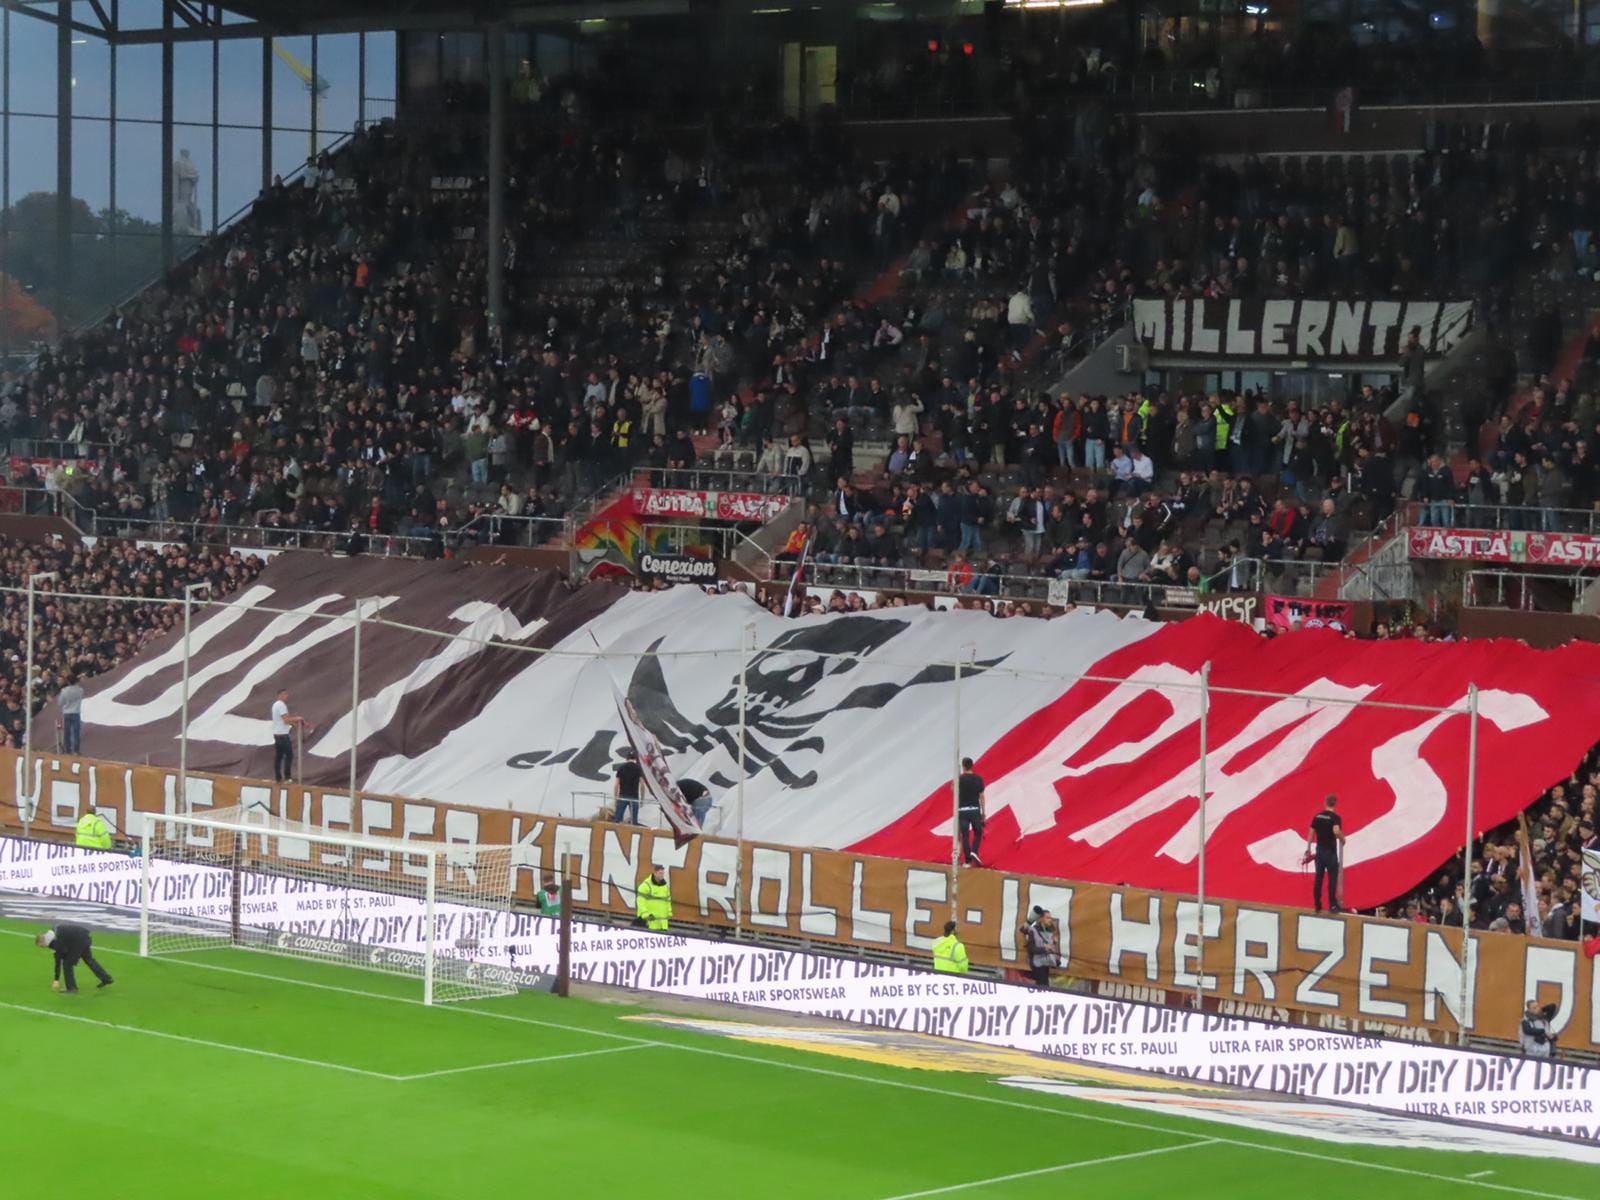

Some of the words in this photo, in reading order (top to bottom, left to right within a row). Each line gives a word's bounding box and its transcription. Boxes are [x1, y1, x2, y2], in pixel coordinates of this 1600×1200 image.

[11, 868, 33, 879] PAULI
[51, 864, 76, 876] ULTRA
[79, 861, 96, 873] FAIR
[98, 858, 154, 872] SPORTSWER
[197, 905, 216, 915] FAIR
[297, 901, 323, 911] MADE
[326, 901, 338, 909] BY
[369, 896, 396, 908] PAULI
[295, 936, 347, 953] congstar
[591, 940, 613, 951] FAIR
[616, 936, 687, 950] SPORTSWEAR
[387, 951, 440, 970] congstr
[1109, 893, 1478, 1029] HERZEN
[483, 966, 540, 986] congstar
[743, 990, 766, 1002] FAIR
[770, 986, 846, 1001] SPORTSWEAR
[870, 985, 904, 997] MADE
[908, 984, 921, 996] BY
[926, 983, 939, 995] FC
[943, 983, 959, 995] ST.
[963, 982, 997, 994] PAULI
[1042, 1043, 1078, 1055] MADE
[1082, 1043, 1097, 1055] BY
[1102, 1043, 1116, 1055] FC
[1120, 1042, 1137, 1055] ST.
[1141, 1042, 1178, 1055] PAULI
[1210, 1040, 1250, 1053] ULTRA
[1255, 1039, 1284, 1052] FAIR
[1289, 1037, 1382, 1051] SPORTSWEAR
[1455, 1101, 1486, 1114] FAIR
[1491, 1100, 1593, 1113] SPORTSWEAR
